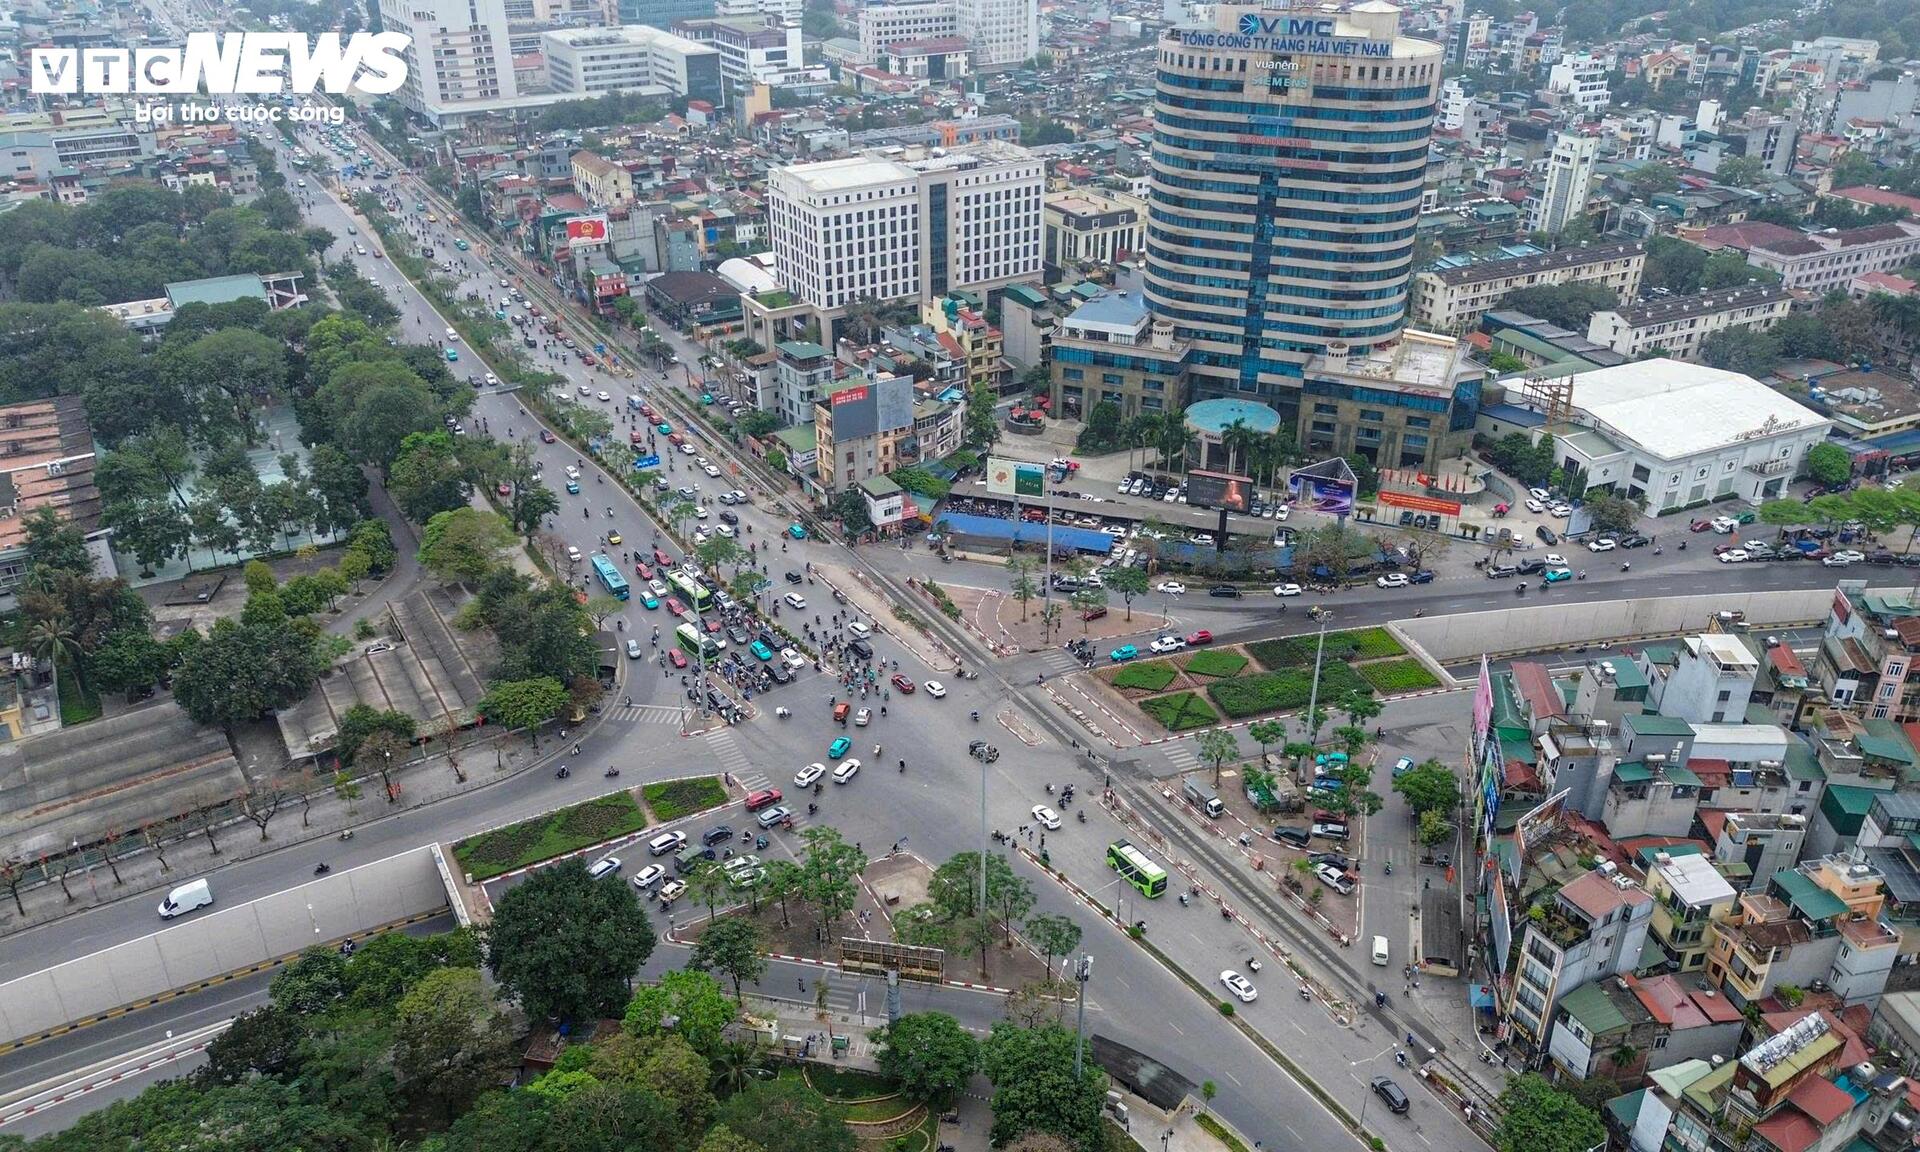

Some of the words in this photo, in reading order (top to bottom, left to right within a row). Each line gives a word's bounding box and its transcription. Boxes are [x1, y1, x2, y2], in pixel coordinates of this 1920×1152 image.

[1259, 18, 1333, 37] VIMC
[1217, 32, 1251, 48] CÔNG
[1253, 37, 1270, 50] TY
[1332, 39, 1359, 57] VIỆT
[1361, 43, 1390, 57] NAM
[1251, 77, 1309, 89] SIEMENS
